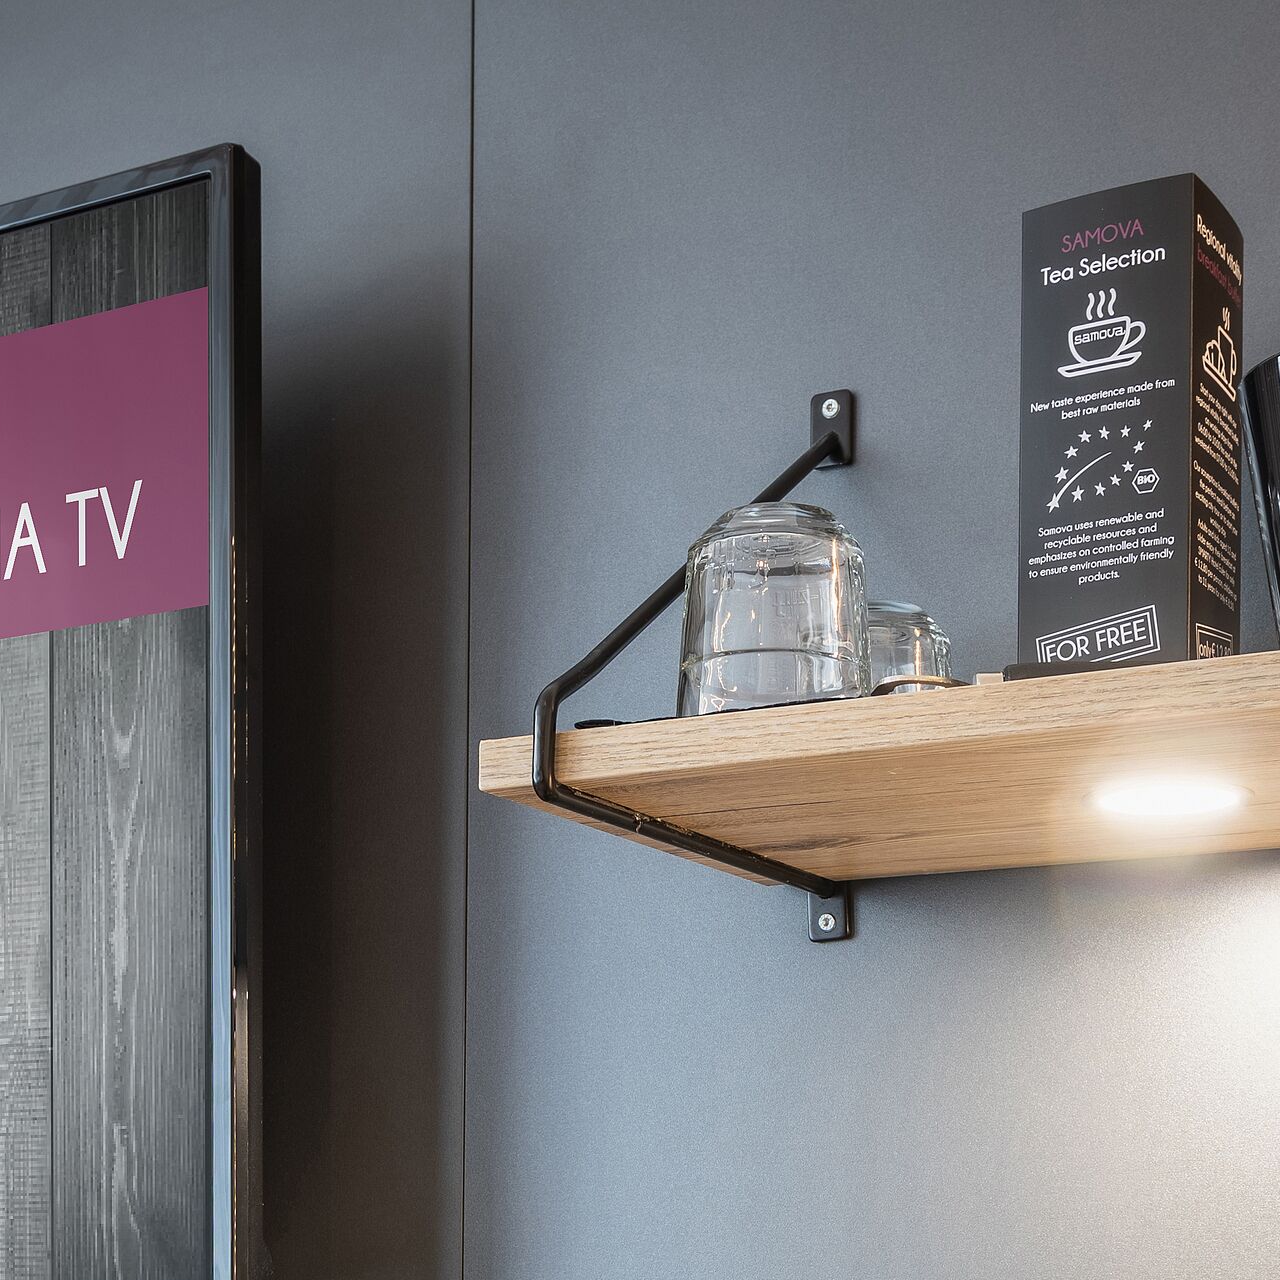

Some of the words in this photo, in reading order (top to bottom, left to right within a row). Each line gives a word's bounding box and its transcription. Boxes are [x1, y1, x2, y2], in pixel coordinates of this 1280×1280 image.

[1061, 218, 1144, 253] SAMOVA
[1040, 265, 1073, 286] Tea
[1079, 247, 1166, 277] Selection
[1074, 326, 1127, 345] samova
[1030, 403, 1050, 413] New
[1051, 396, 1073, 409] taste
[1075, 387, 1125, 404] experience
[1127, 381, 1153, 394] made
[1155, 379, 1175, 389] from
[1061, 408, 1081, 420] best
[1082, 406, 1099, 416] raw
[1100, 397, 1141, 412] materials
[66, 479, 143, 568] TV
[1038, 524, 1073, 537] Samova
[1074, 520, 1094, 531] uses
[1095, 512, 1143, 527] renewable
[1145, 508, 1165, 519] and
[1044, 533, 1091, 550] recyclable
[1093, 527, 1136, 541] resources
[1138, 523, 1158, 534] and
[1028, 550, 1076, 566] emphasizes
[1079, 547, 1091, 556] on
[1092, 539, 1139, 555] controlled
[1140, 535, 1175, 549] farming
[1028, 570, 1038, 579] to
[1040, 565, 1068, 577] ensure
[1070, 553, 1139, 573] environmentally
[1140, 548, 1174, 562] friendly
[1078, 570, 1120, 585] products.
[1045, 635, 1090, 662] FOR
[1095, 619, 1147, 652] FREE
